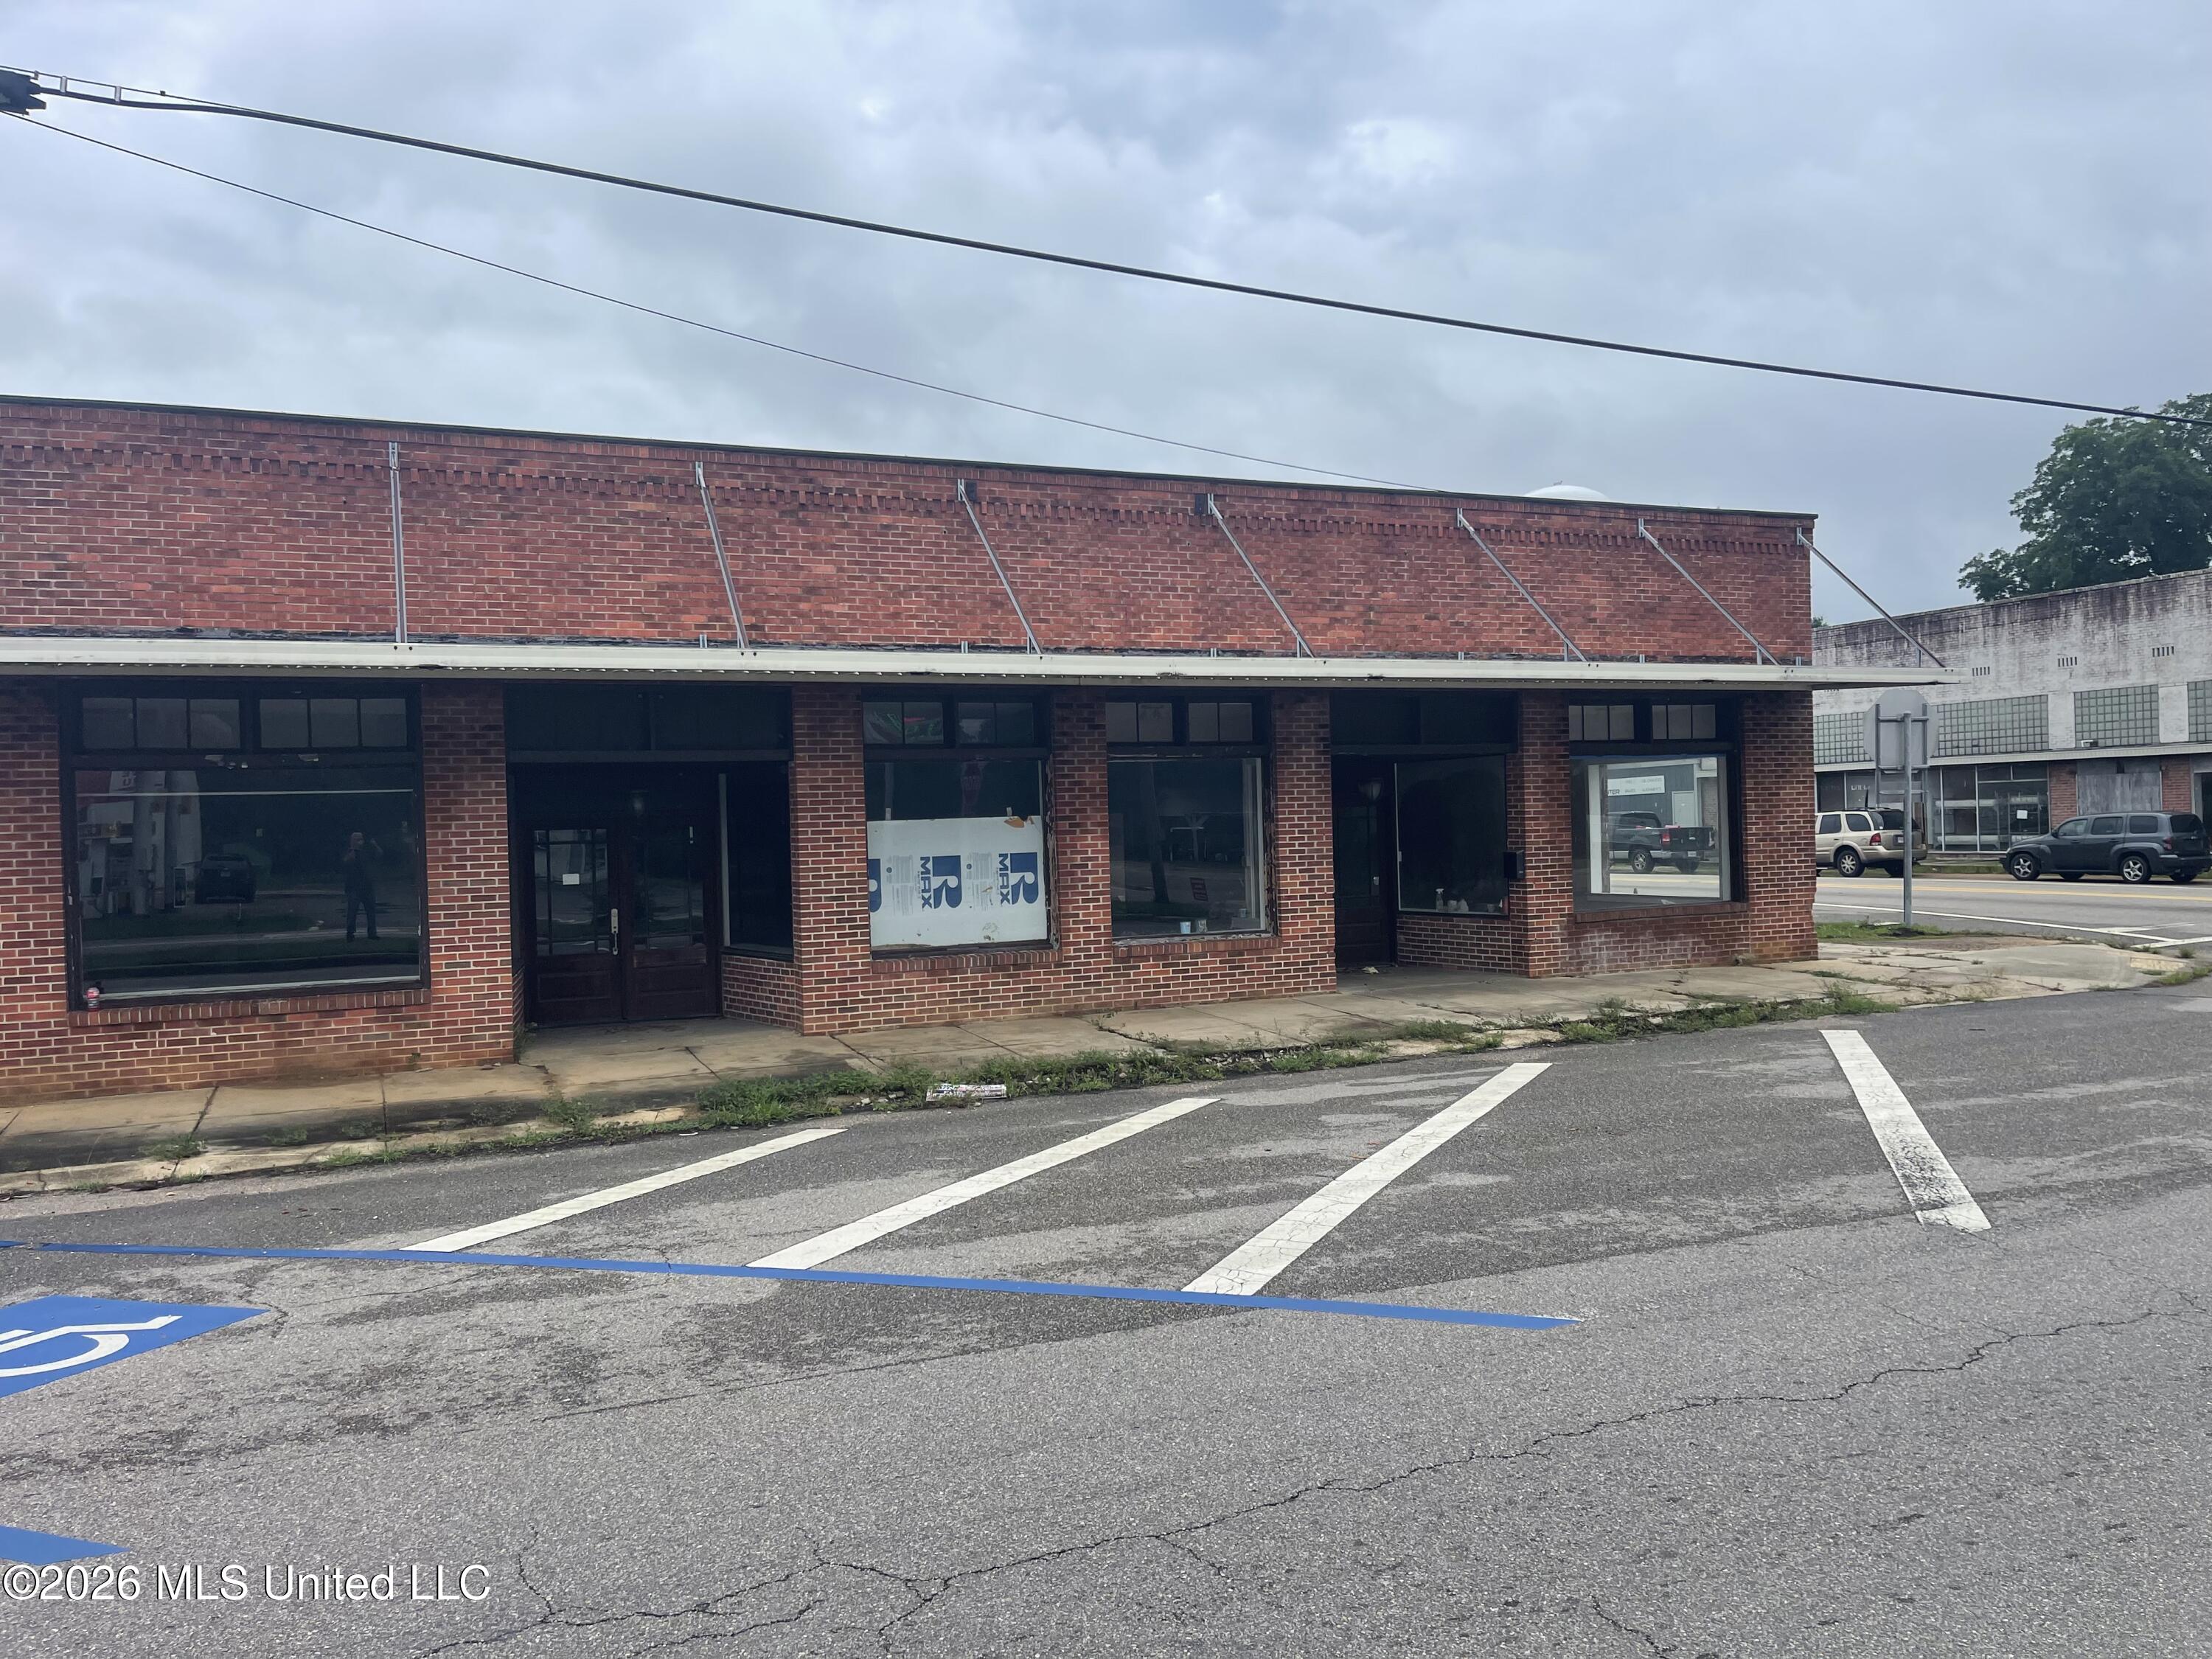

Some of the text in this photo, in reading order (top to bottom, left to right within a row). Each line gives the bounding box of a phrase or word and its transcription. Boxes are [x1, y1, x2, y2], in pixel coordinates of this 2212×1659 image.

[920, 856, 932, 909] MAX
[932, 855, 962, 909] R
[998, 853, 1010, 905] MAX
[1010, 852, 1039, 905] R
